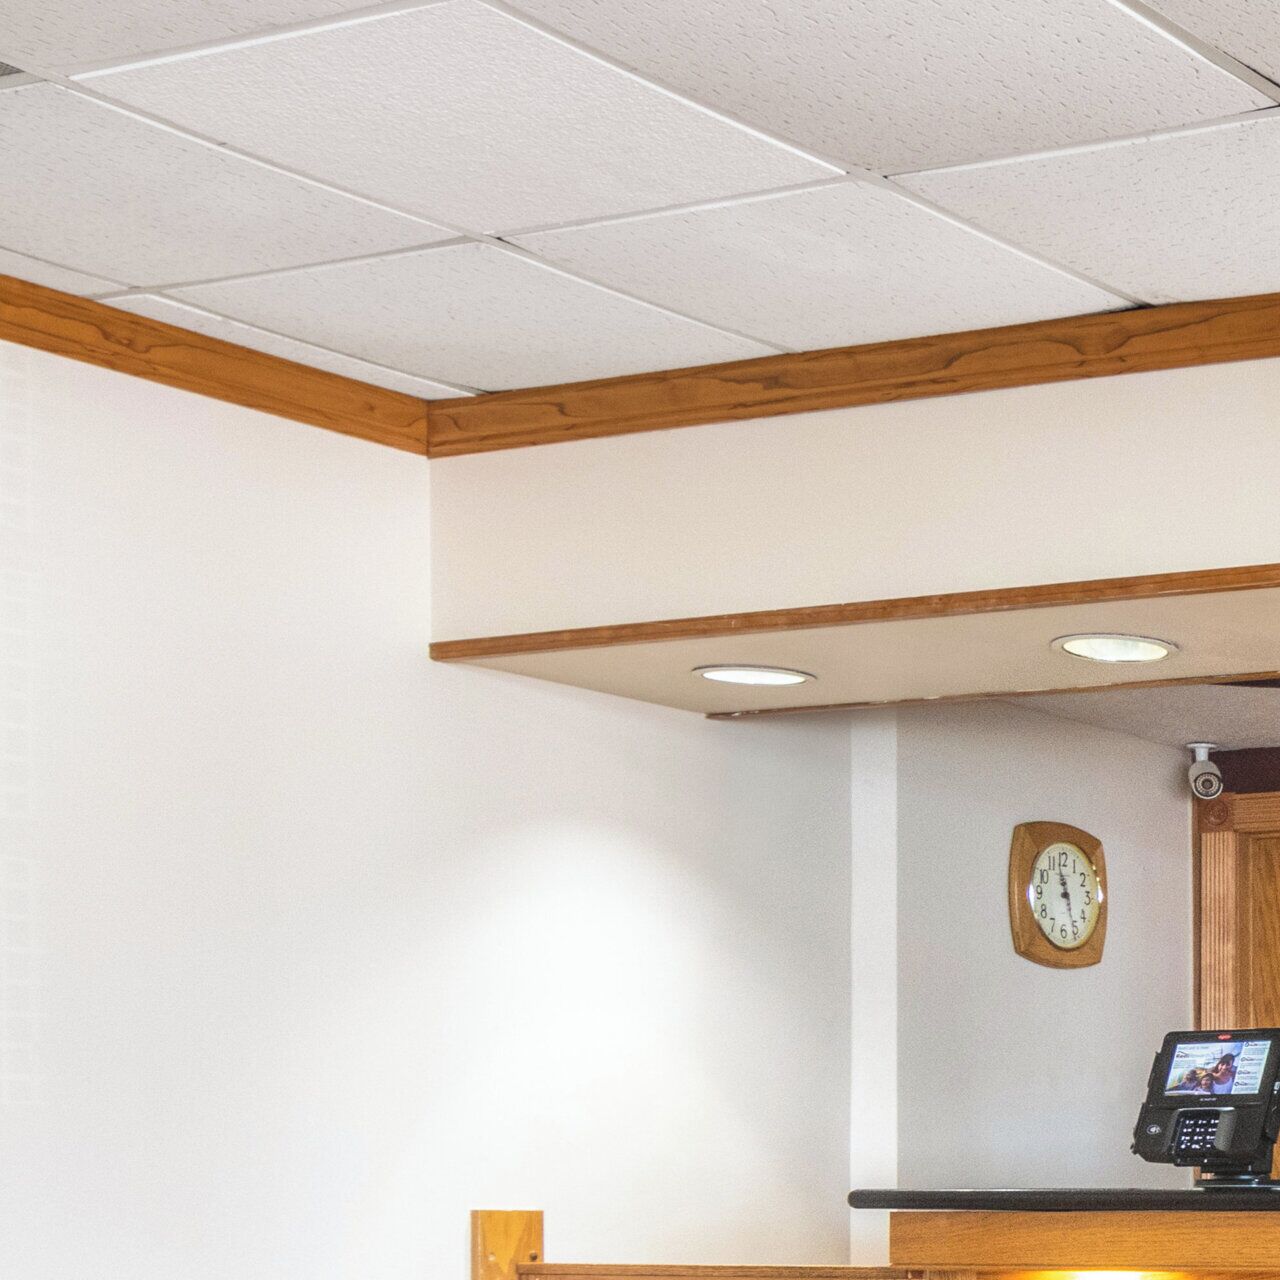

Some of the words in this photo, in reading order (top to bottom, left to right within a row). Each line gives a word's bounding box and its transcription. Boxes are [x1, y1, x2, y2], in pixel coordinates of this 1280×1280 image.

[1048, 856, 1056, 871] 11
[1058, 851, 1068, 868] 12
[1040, 869, 1049, 884] 10
[1080, 872, 1087, 887] 2
[1036, 885, 1043, 900] 9
[1084, 891, 1091, 905] 3
[1040, 904, 1047, 918] 8
[1081, 909, 1087, 923] 4
[1050, 918, 1056, 933] 7
[1060, 924, 1067, 939] 6
[1072, 920, 1079, 936] 5
